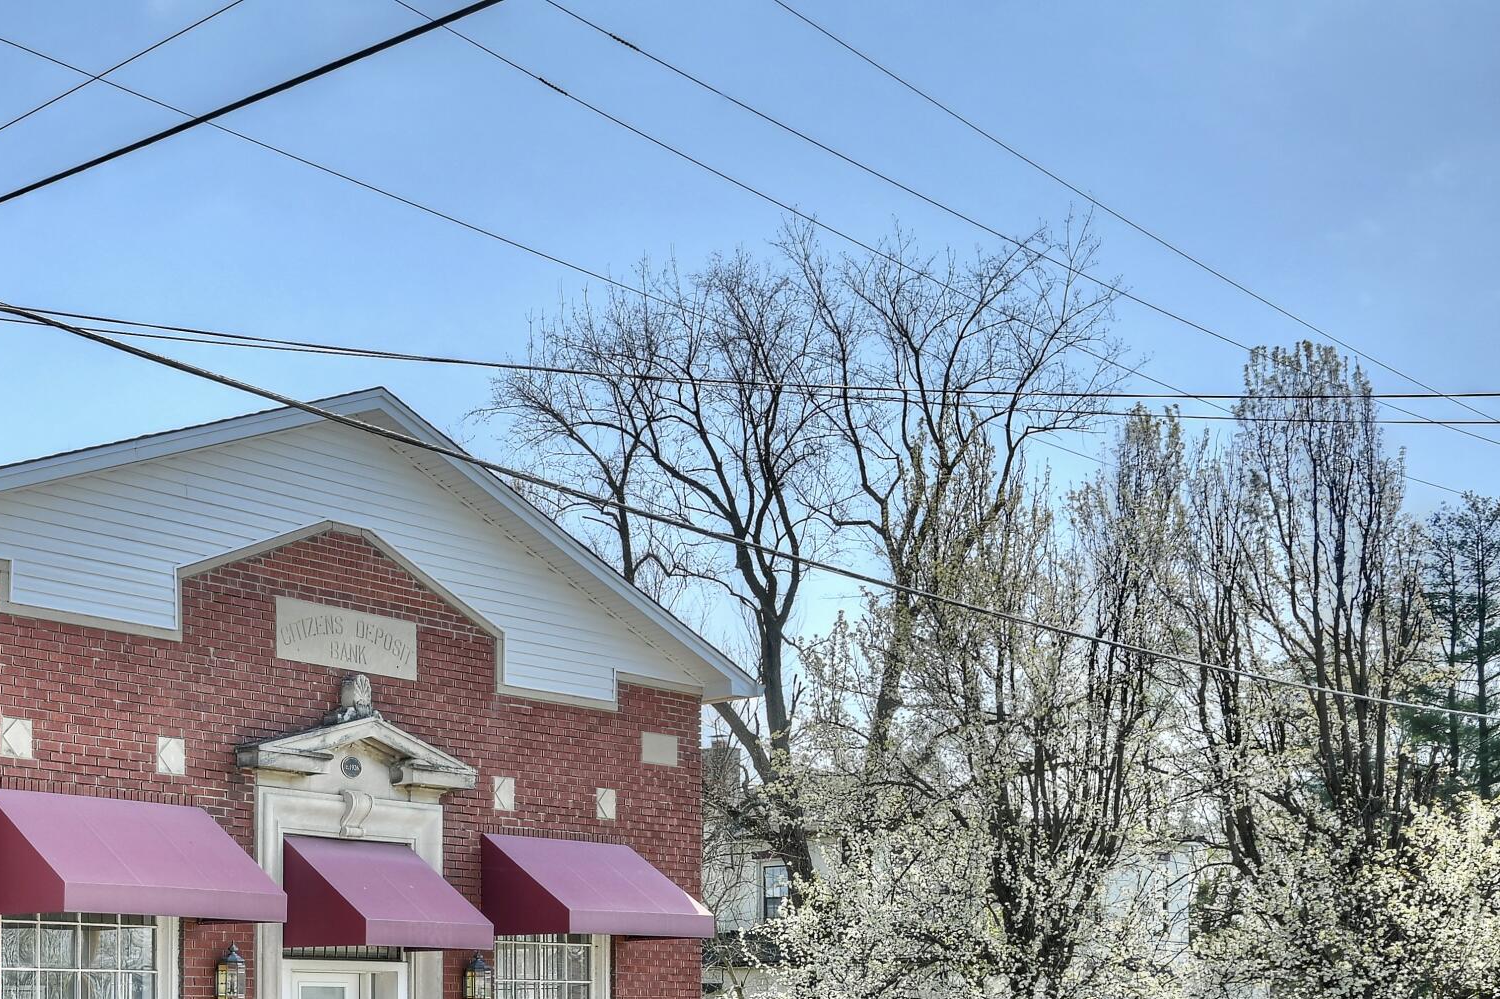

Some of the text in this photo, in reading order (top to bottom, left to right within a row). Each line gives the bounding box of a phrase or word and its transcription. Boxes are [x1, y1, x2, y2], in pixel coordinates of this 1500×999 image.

[280, 615, 415, 665] CITIZENS DEPOSIT
[329, 640, 367, 665] BANK
